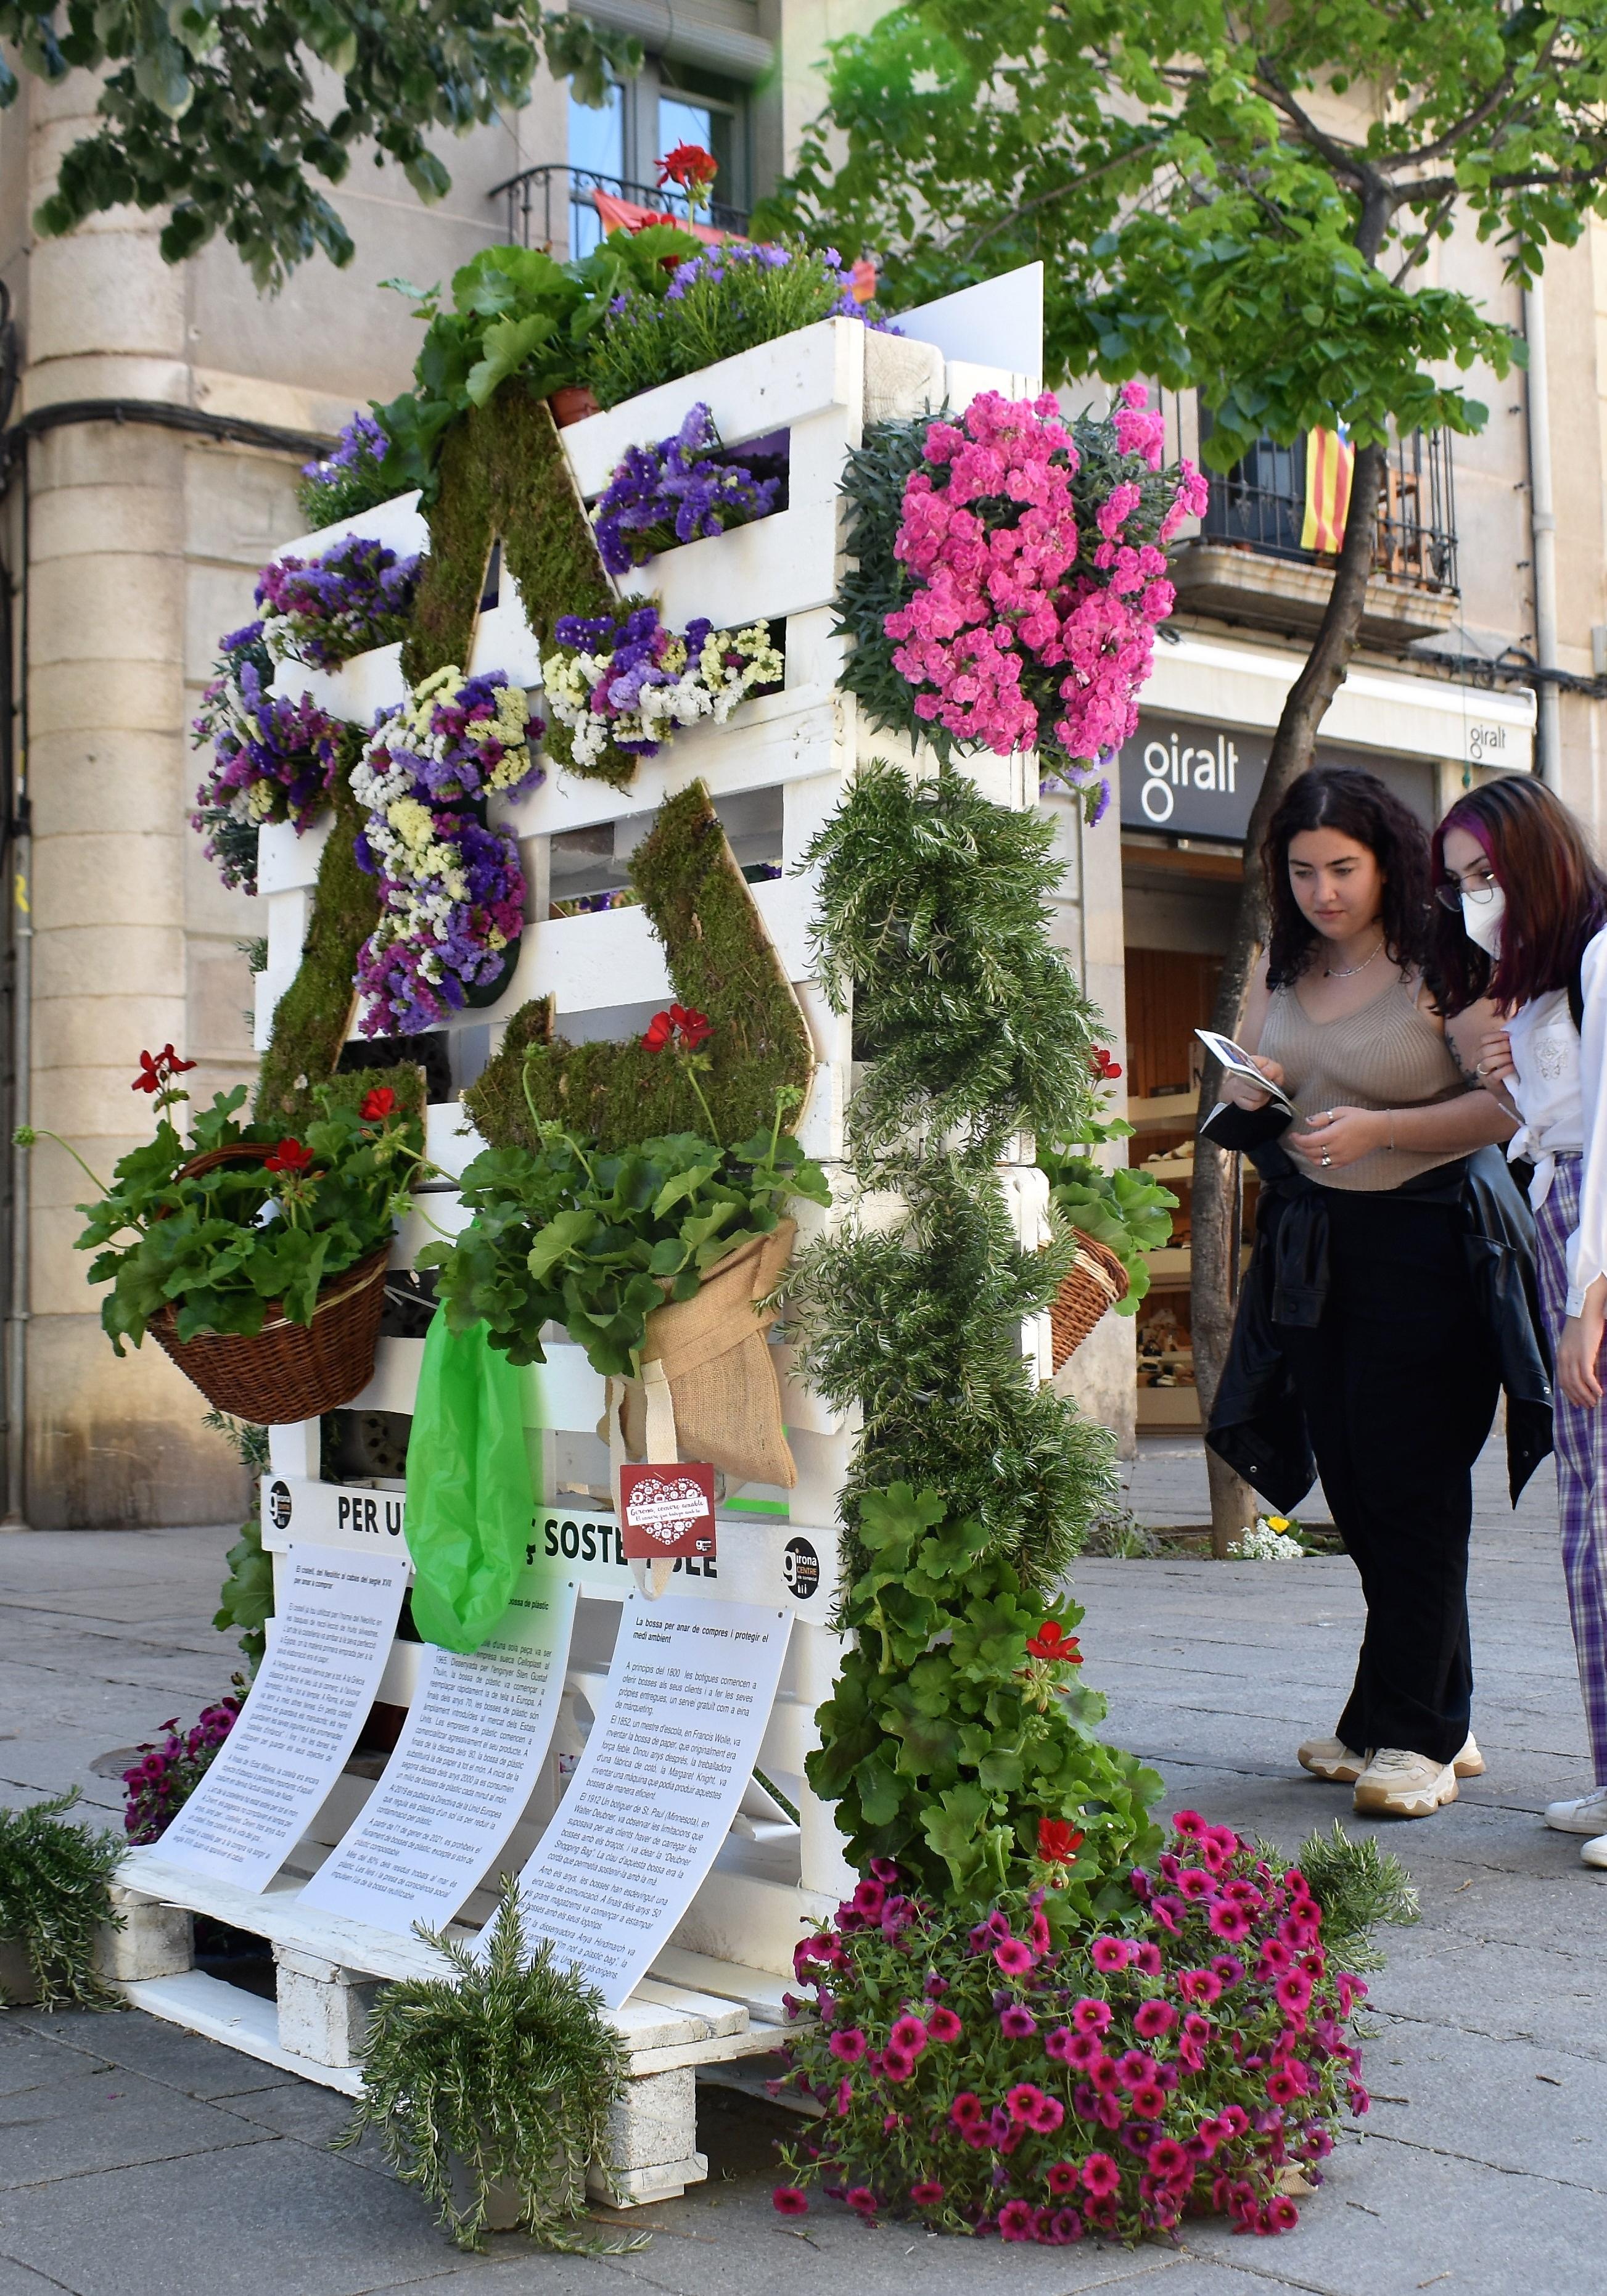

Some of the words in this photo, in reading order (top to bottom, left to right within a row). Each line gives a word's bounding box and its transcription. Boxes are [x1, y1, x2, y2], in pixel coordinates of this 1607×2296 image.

[1470, 725, 1505, 759] giralt
[1141, 733, 1238, 823] giralt
[339, 1496, 379, 1534] PER
[386, 1501, 405, 1536] U
[797, 1566, 816, 1576] CENTRE
[633, 1631, 647, 1640] medi
[647, 1633, 671, 1643] ambient
[636, 1617, 643, 1626] La
[645, 1618, 662, 1628] bossa
[664, 1623, 675, 1631] per
[676, 1624, 690, 1632] anar
[692, 1624, 700, 1633] de
[702, 1627, 728, 1637] compres
[730, 1629, 733, 1637] i
[734, 1632, 760, 1642] protegir
[762, 1634, 769, 1642] el
